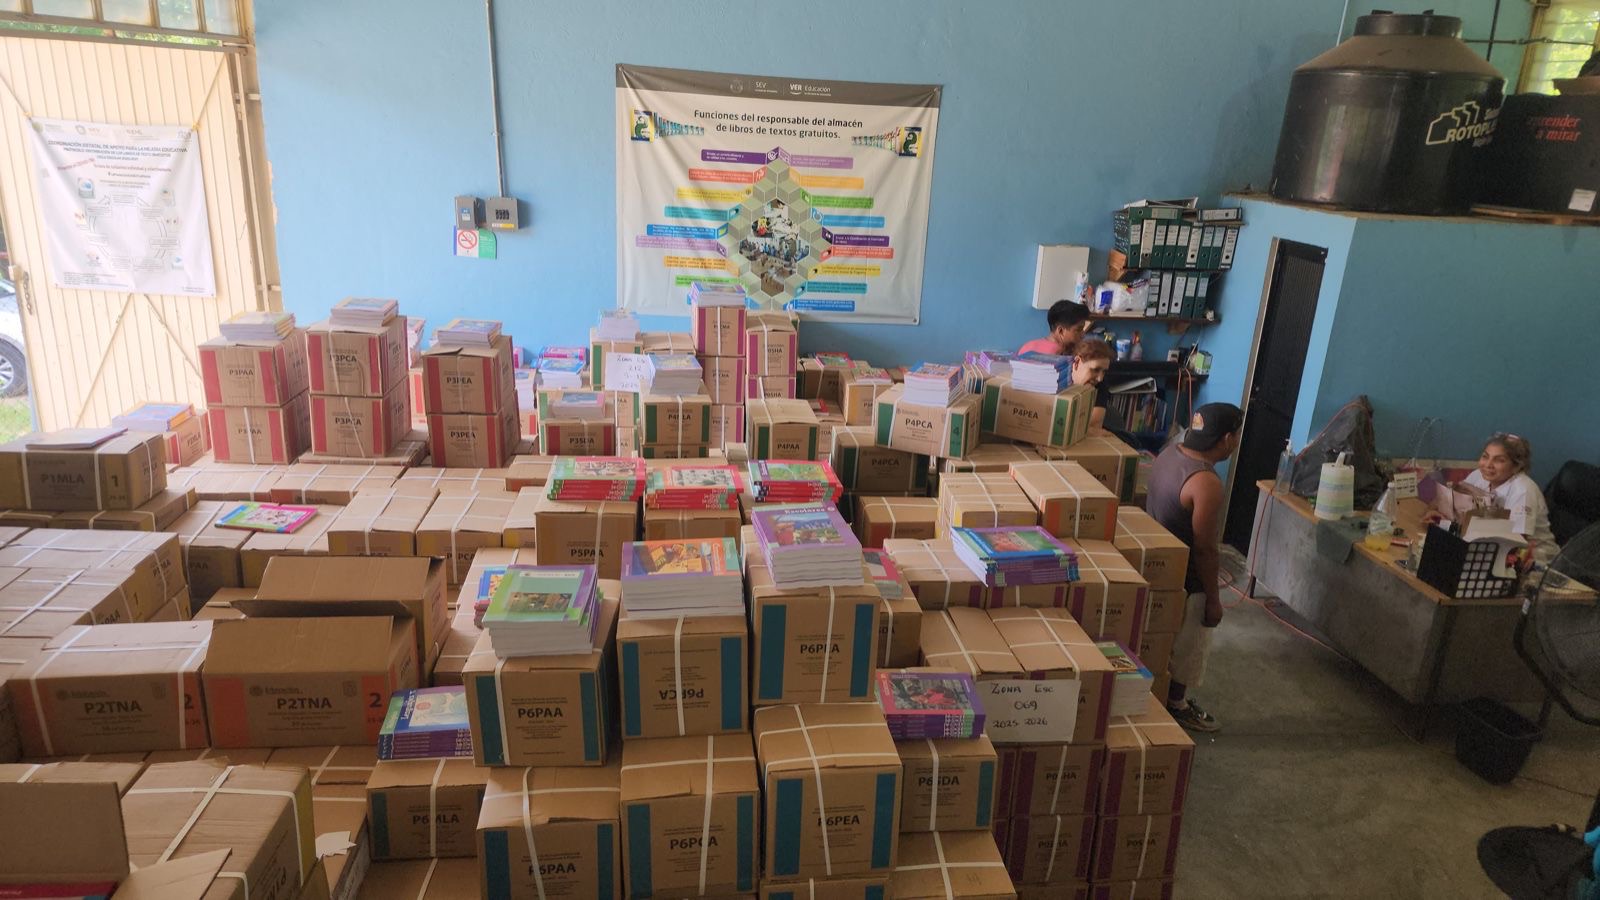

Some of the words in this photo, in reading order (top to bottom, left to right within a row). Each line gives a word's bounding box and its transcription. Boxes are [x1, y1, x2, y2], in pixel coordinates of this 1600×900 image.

[790, 83, 802, 91] VER
[804, 84, 831, 92] Educación
[694, 109, 739, 121] Funciones
[741, 112, 755, 122] del
[757, 115, 810, 126] responsable
[812, 117, 826, 126] del
[827, 118, 863, 128] almacén
[716, 123, 727, 132] de
[729, 124, 754, 133] libros
[756, 125, 767, 134] de
[769, 127, 797, 136] textos
[799, 128, 841, 139] gratuitos.
[229, 368, 254, 377] P3PAA
[1012, 407, 1039, 420] P4PEA
[905, 418, 933, 430] P4PCA
[871, 457, 900, 467] P4PCA
[40, 474, 85, 485] P1MLA
[1069, 513, 1096, 521] PTNA
[447, 552, 476, 561] PPCA
[570, 549, 604, 558] P5PAA
[184, 693, 194, 710] 2
[276, 697, 332, 710] P2TNA
[369, 692, 383, 708] 2
[84, 700, 142, 714] P2TNA
[518, 706, 563, 719] P6PAA
[1046, 771, 1077, 780] P0HA
